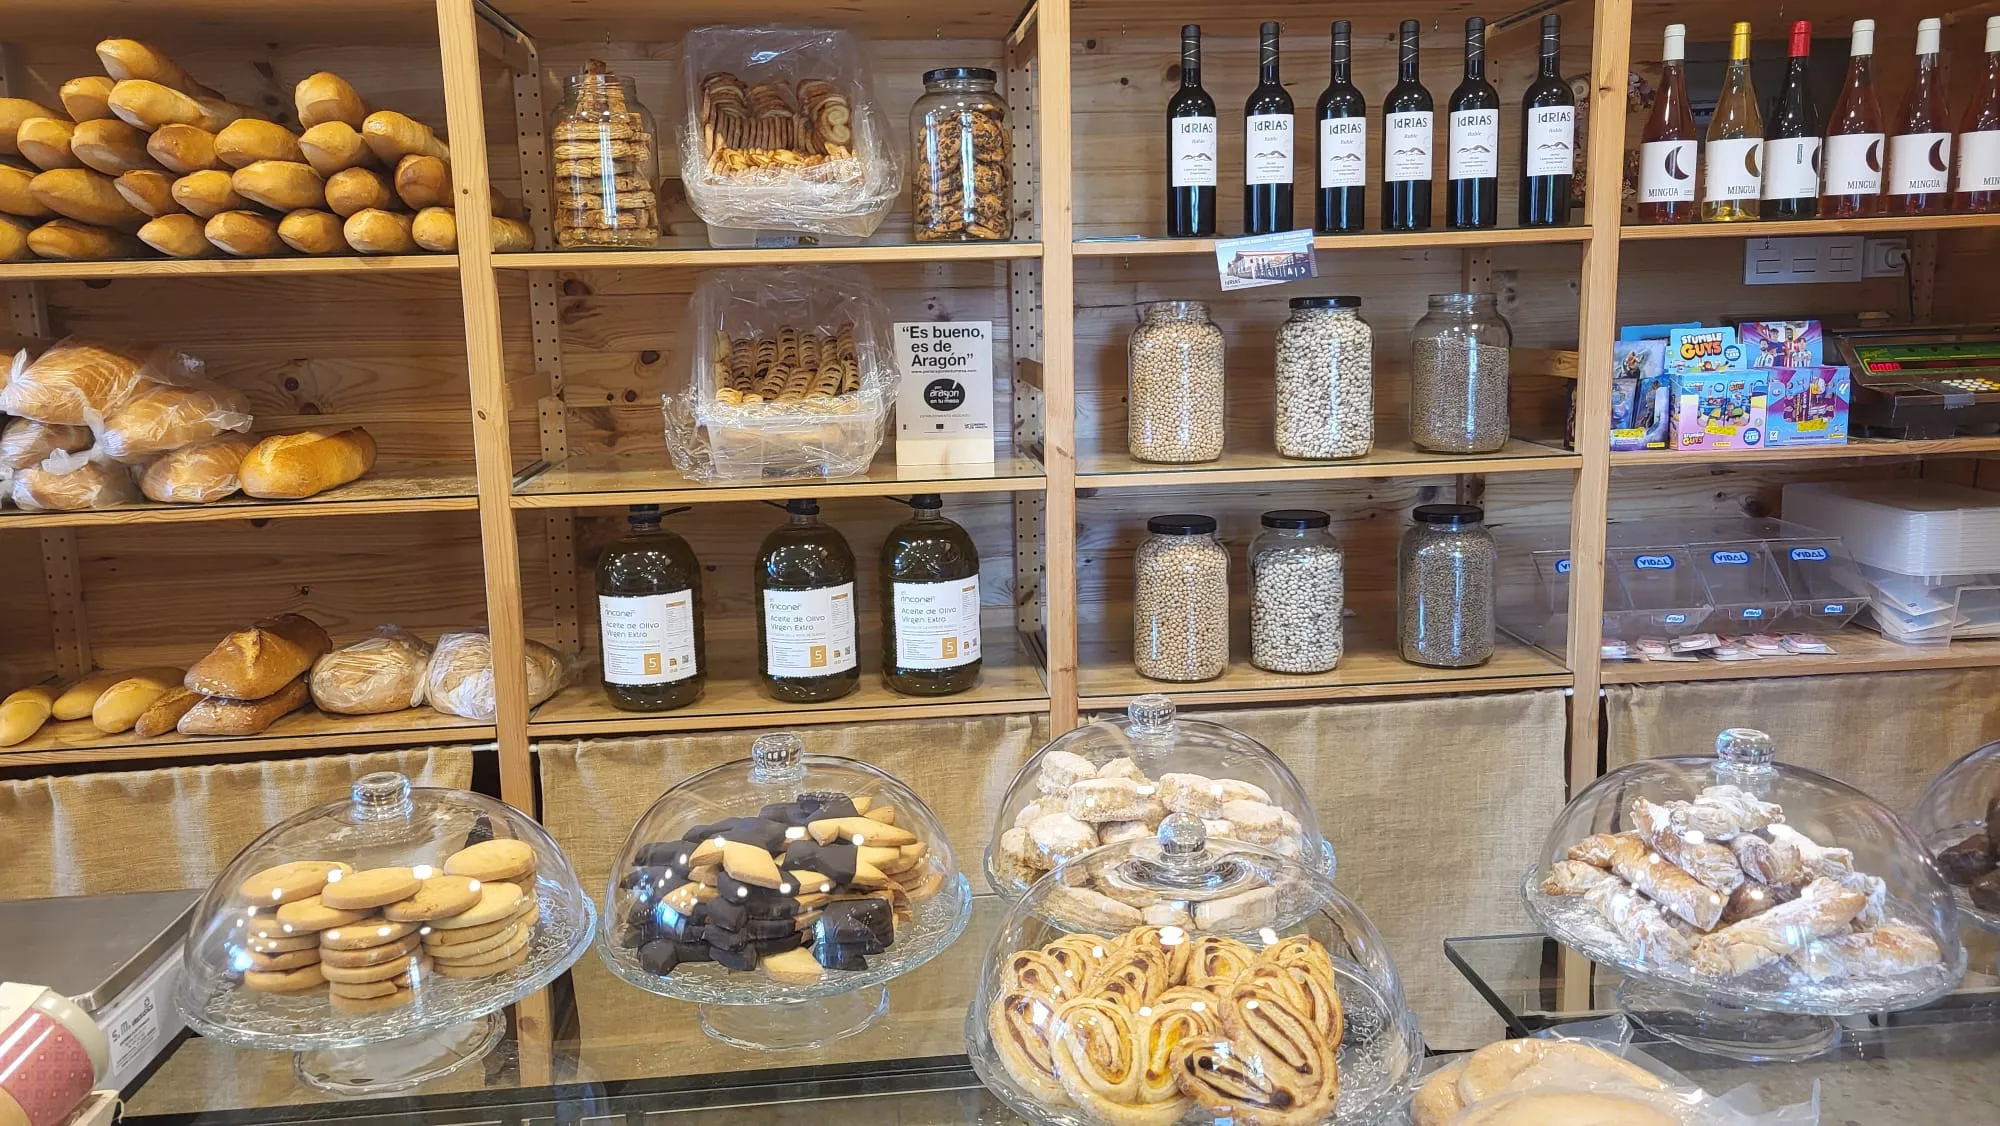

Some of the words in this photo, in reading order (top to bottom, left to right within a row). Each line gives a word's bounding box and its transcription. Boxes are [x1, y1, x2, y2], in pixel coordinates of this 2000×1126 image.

[1847, 180, 1876, 189] MINGUA
[1909, 180, 1940, 189] MINGUA
[1648, 188, 1679, 198] MINGUA
[1727, 186, 1756, 195] MINGUA
[933, 326, 984, 340] bueno,
[1681, 332, 1722, 345] STUMBLE
[912, 342, 928, 353] es
[933, 340, 952, 353] de
[1681, 342, 1722, 360] GUYS
[1682, 437, 1703, 446] GUYS
[1640, 558, 1669, 566] VIDAL
[1716, 554, 1746, 562] VIDAL
[946, 641, 953, 652] 5
[815, 650, 822, 660] 5
[649, 658, 657, 668] 5
